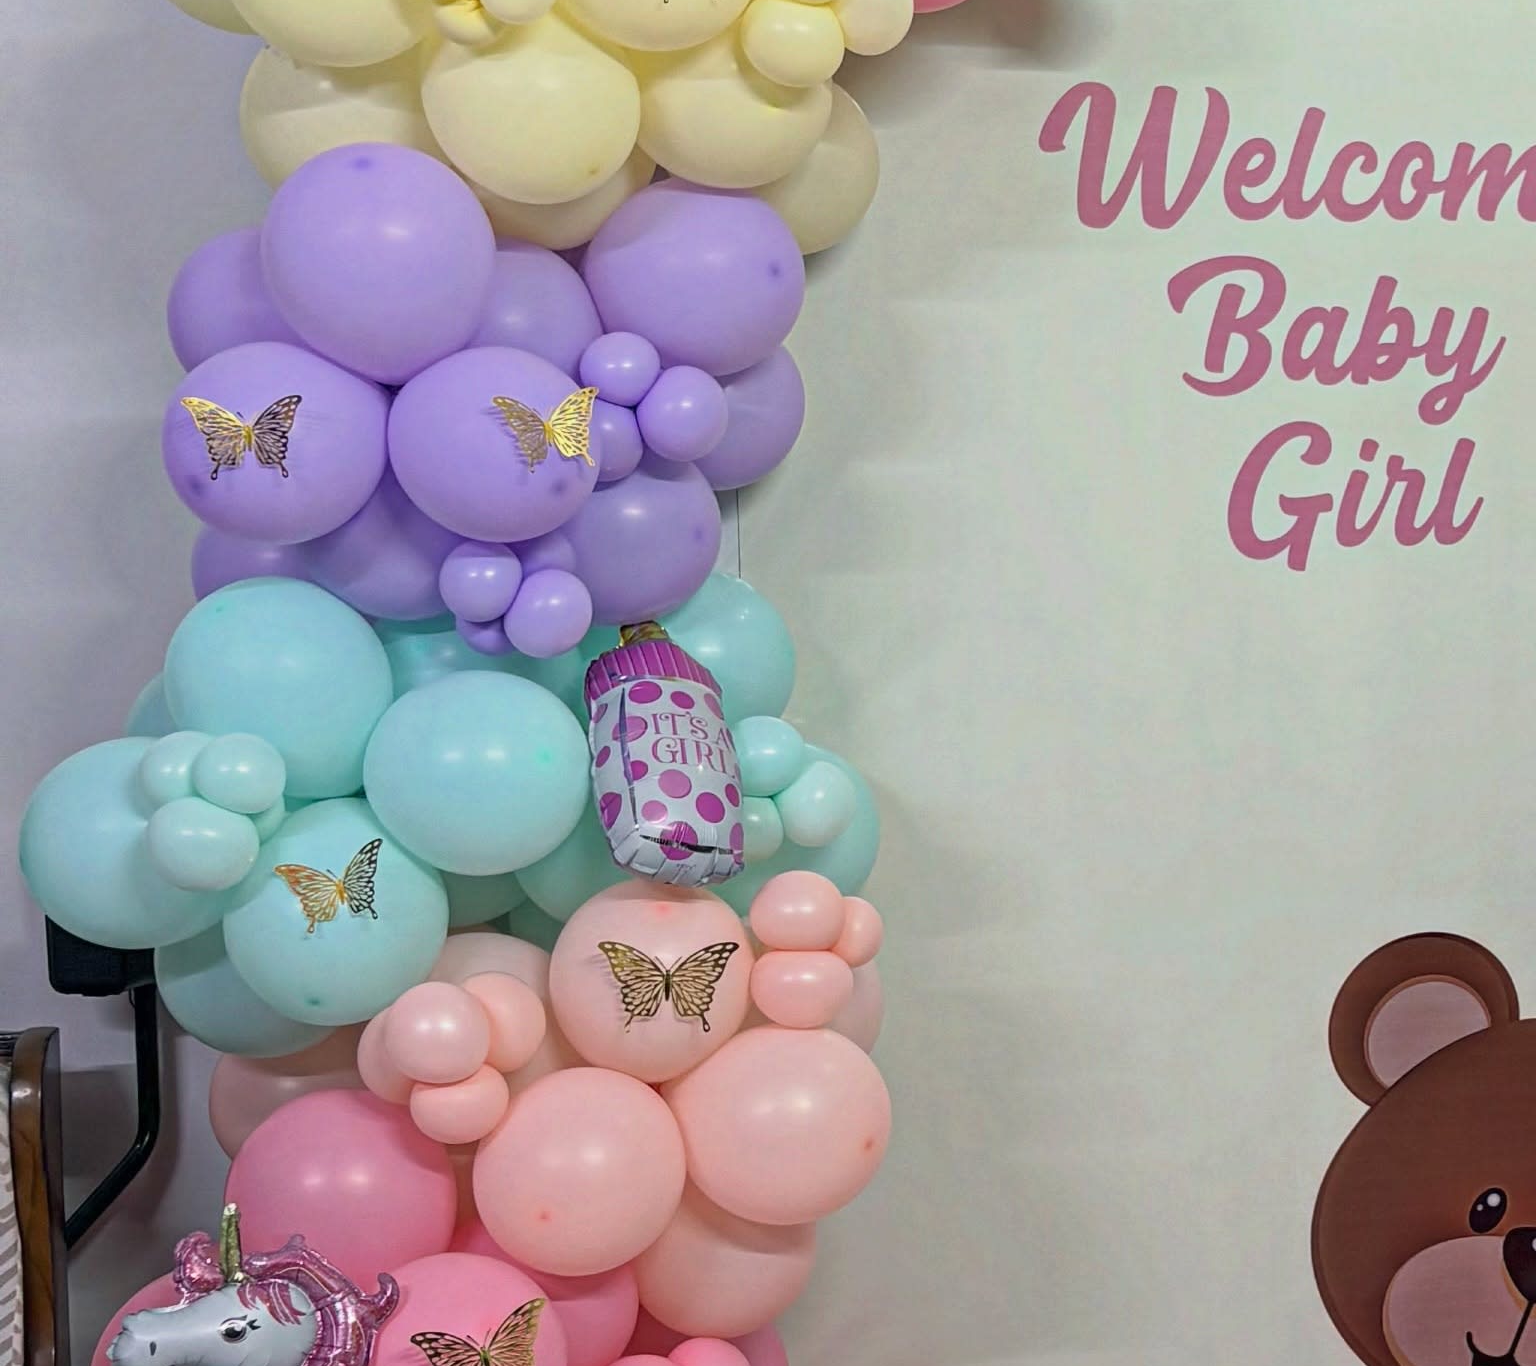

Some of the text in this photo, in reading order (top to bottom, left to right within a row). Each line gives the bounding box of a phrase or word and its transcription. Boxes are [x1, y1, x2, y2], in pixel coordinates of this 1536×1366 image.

[1167, 255, 1506, 426] Baby
[1227, 421, 1484, 572] Girl
[651, 711, 733, 754] IT'S A
[652, 736, 735, 779] GIRL
